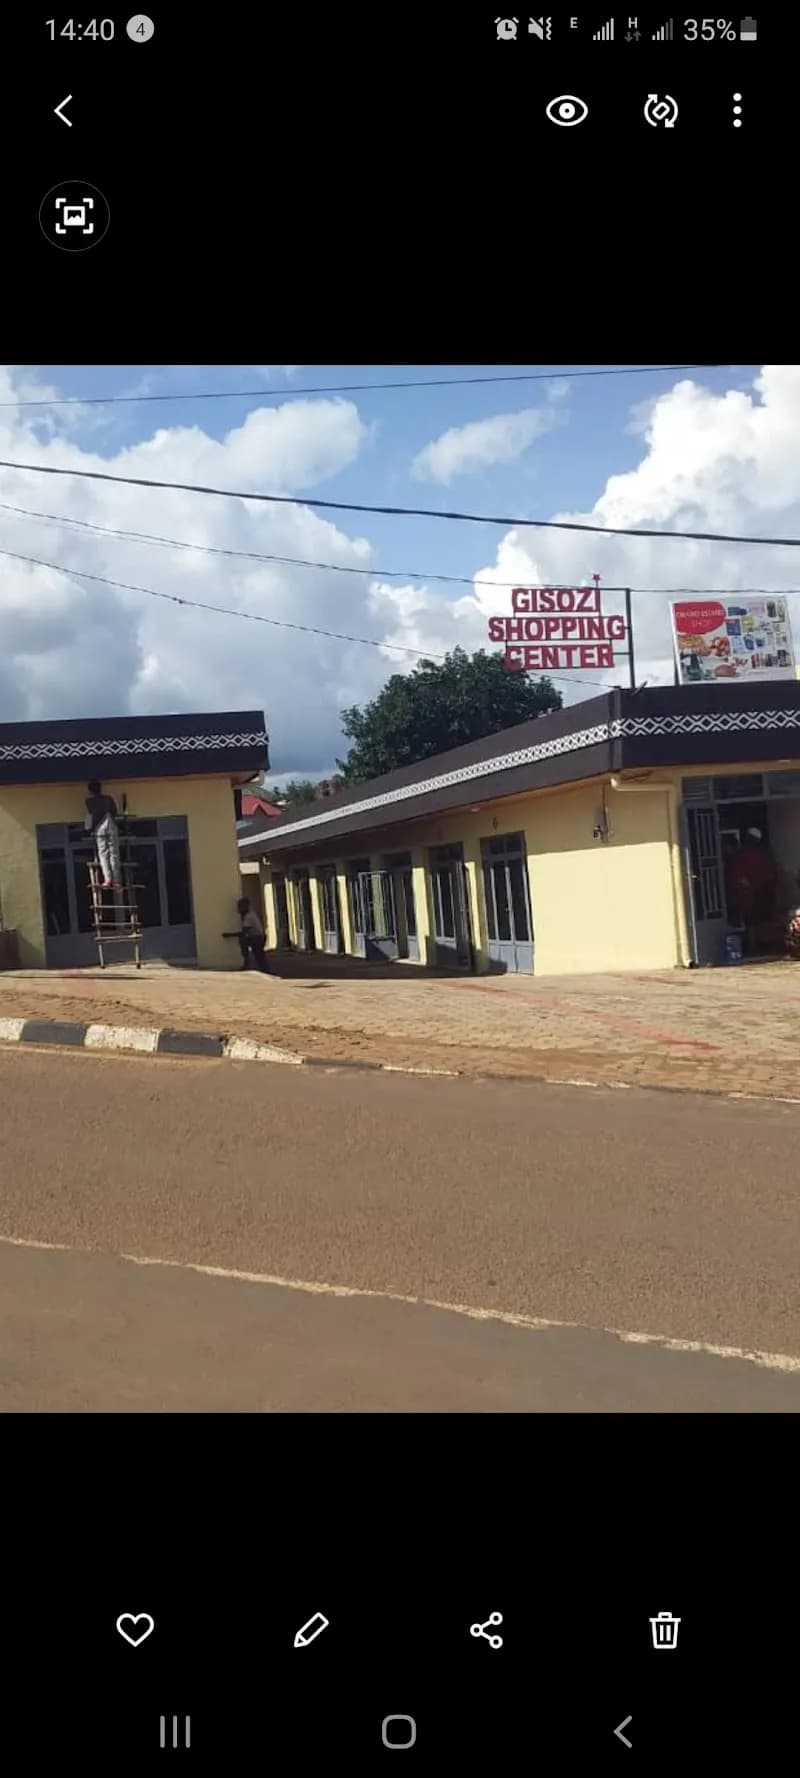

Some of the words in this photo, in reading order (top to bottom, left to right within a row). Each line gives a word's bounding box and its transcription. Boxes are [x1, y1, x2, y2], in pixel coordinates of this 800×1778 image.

[511, 587, 601, 612] GISOZI
[487, 614, 626, 642] SHOPPING
[503, 644, 616, 671] CENTER
